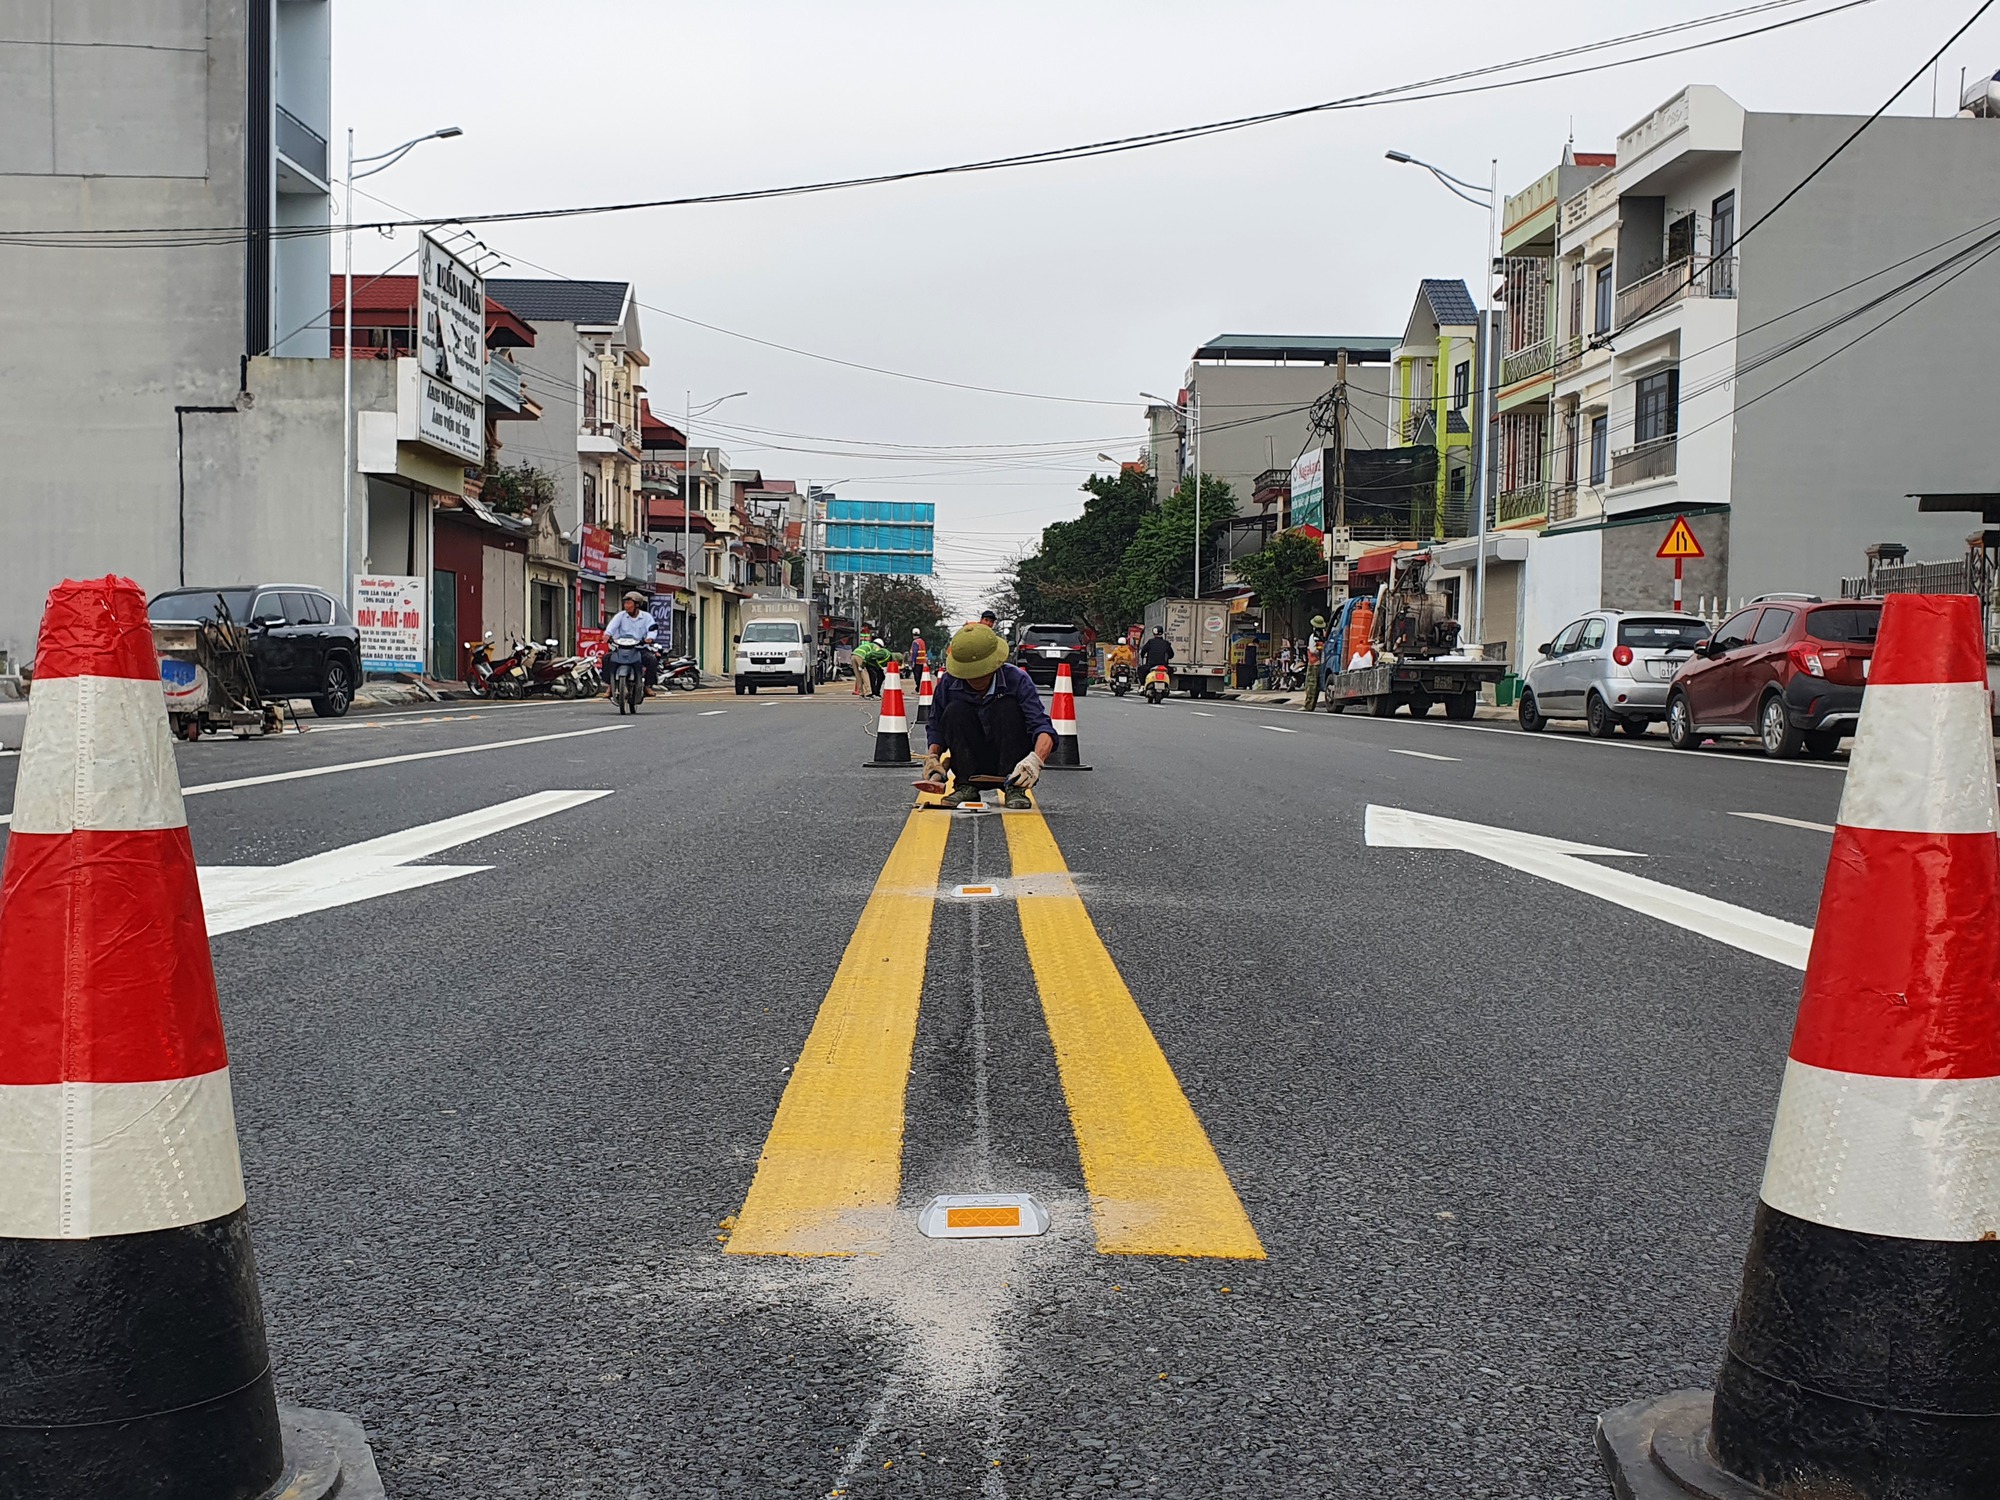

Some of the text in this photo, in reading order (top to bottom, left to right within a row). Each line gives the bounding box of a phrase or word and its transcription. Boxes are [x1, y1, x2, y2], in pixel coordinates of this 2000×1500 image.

[751, 602, 799, 613] XE THƯ BÁO
[358, 605, 419, 629] MÀY MẮT MÔI
